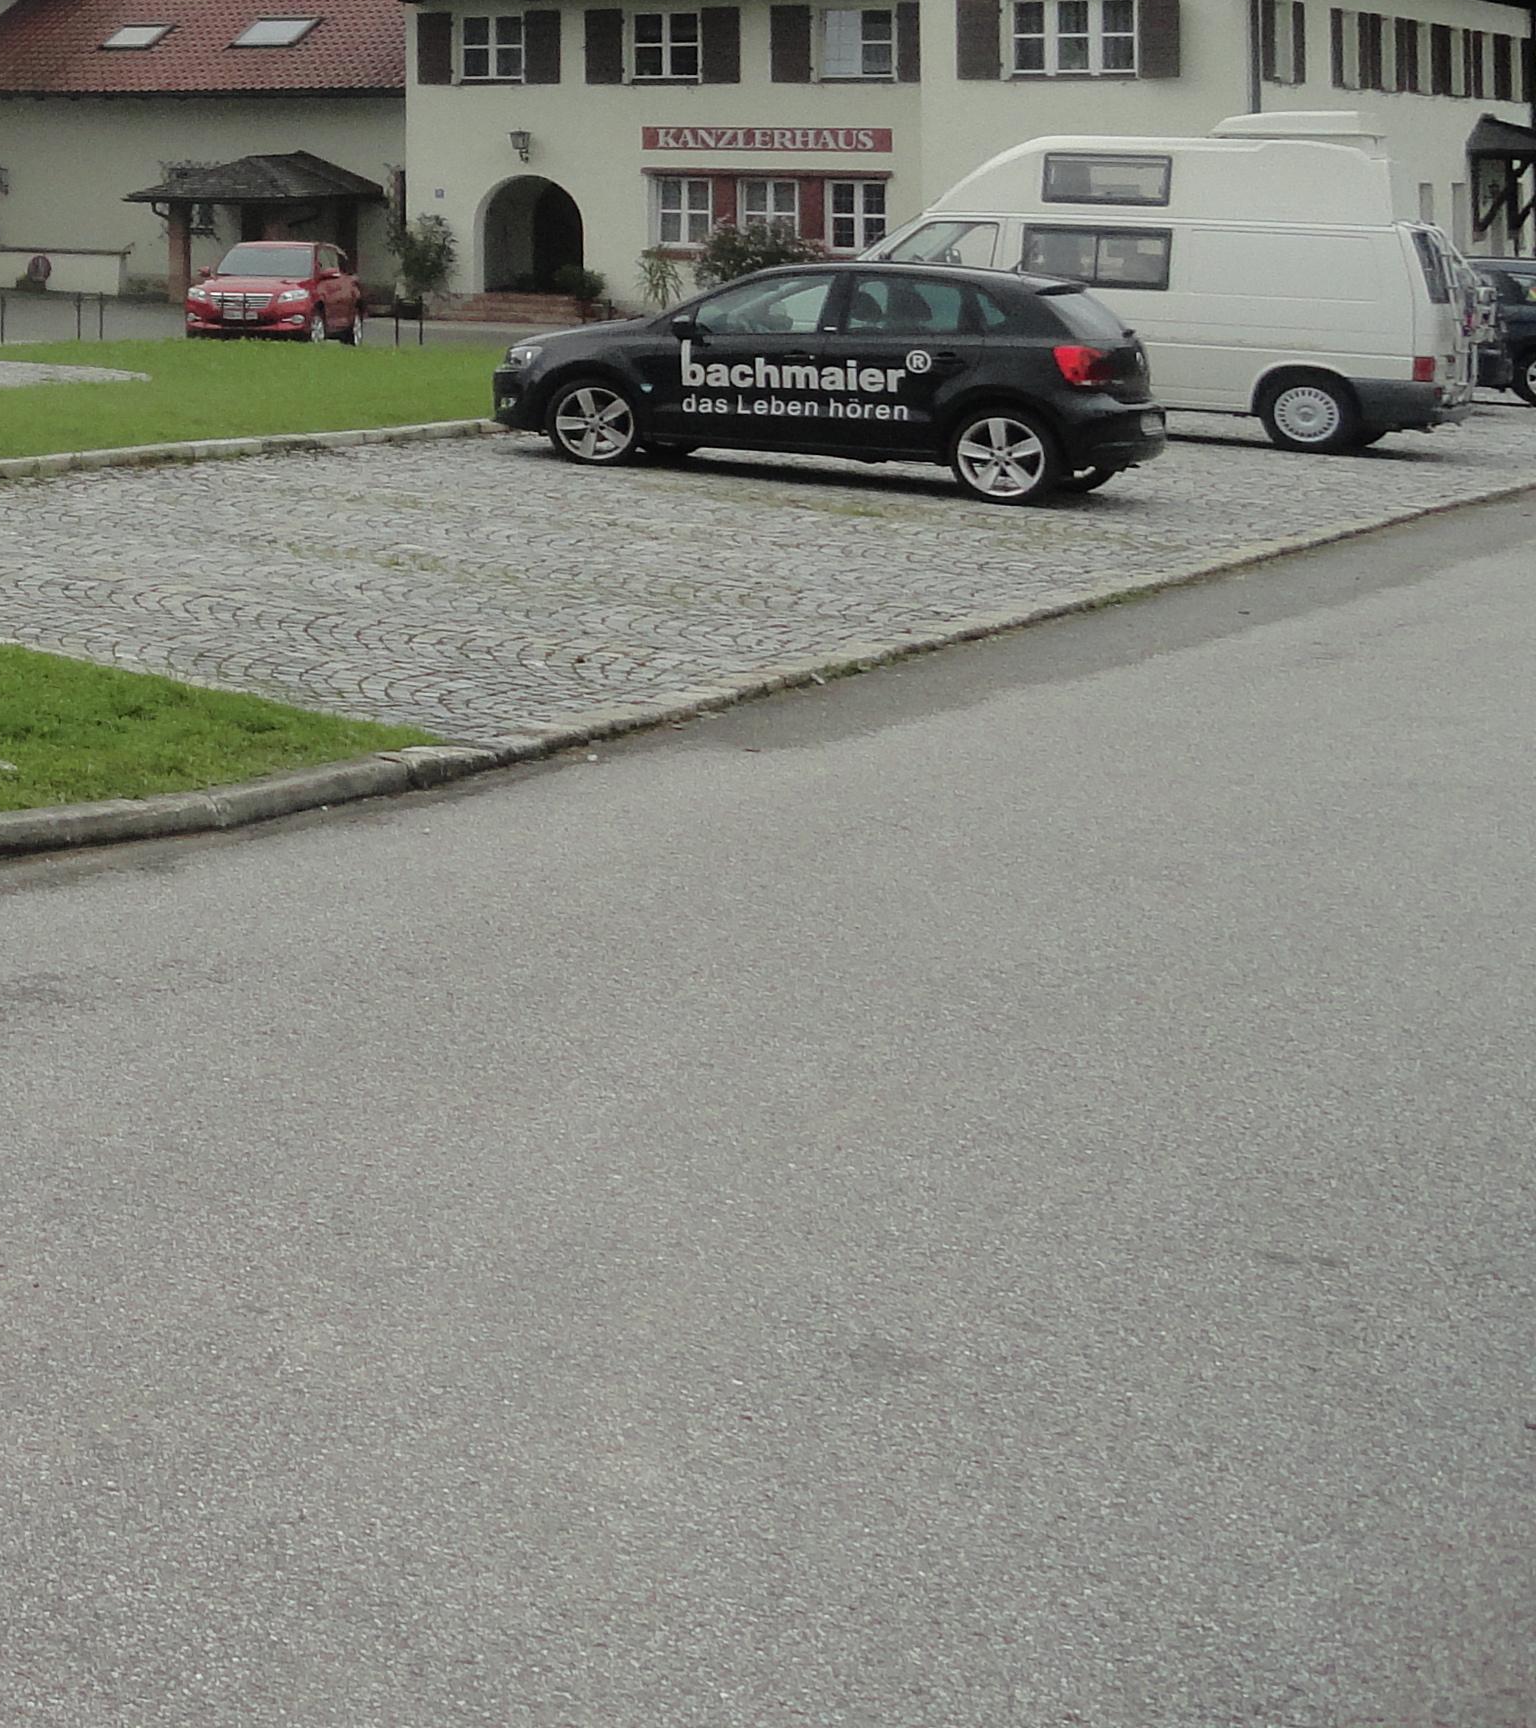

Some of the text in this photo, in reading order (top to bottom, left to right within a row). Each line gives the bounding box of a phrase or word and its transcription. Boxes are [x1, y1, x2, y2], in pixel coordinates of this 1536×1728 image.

[656, 129, 874, 150] KANZLERHAUS
[682, 394, 908, 421] das Leben hören
